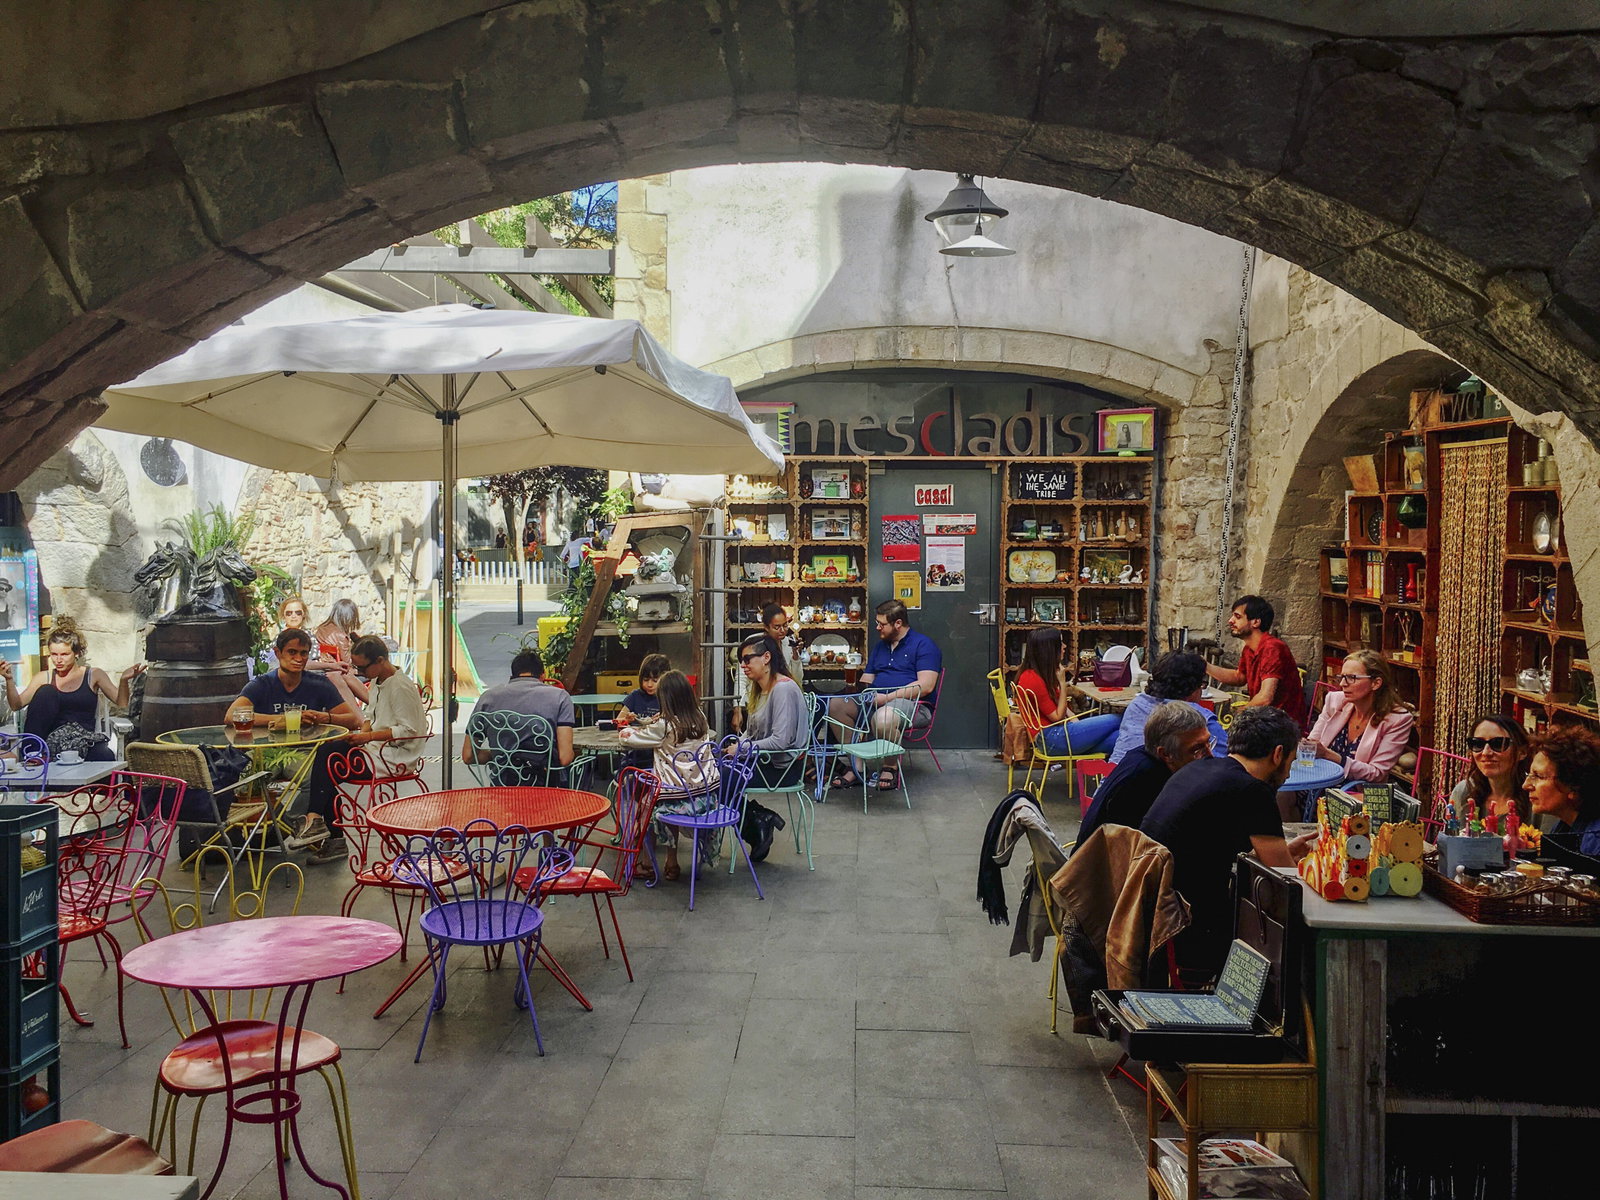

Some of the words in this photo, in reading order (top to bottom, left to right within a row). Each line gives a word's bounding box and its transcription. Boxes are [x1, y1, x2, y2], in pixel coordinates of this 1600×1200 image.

[1026, 473, 1045, 483] WE
[1050, 473, 1068, 484] ALL
[1026, 482, 1039, 490] THE
[1043, 482, 1066, 490] SAME
[917, 485, 951, 504] casal
[1036, 490, 1057, 498] TRIBE
